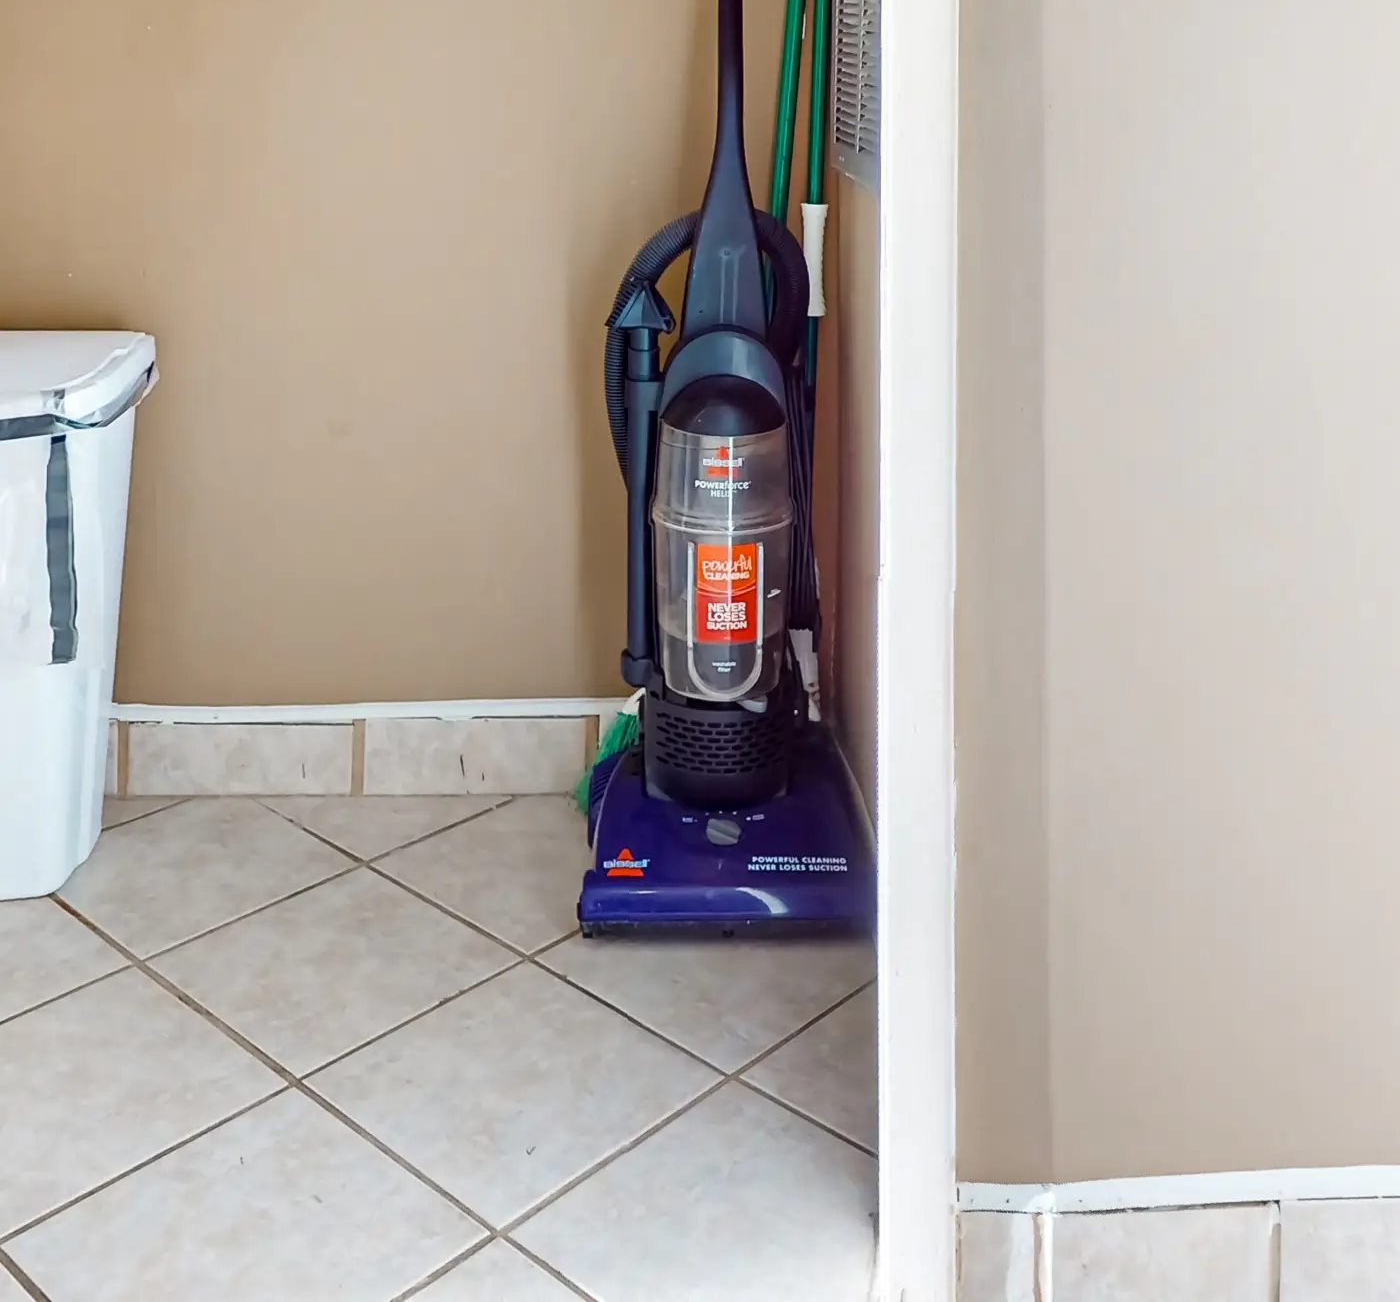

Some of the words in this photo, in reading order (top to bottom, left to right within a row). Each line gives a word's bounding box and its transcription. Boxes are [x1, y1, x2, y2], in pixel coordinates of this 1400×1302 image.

[704, 571, 750, 581] CLEANING
[707, 602, 746, 612] NEVER
[707, 612, 746, 621] LOSES
[706, 621, 748, 630] SUCTION
[808, 864, 848, 872] SUCTION
